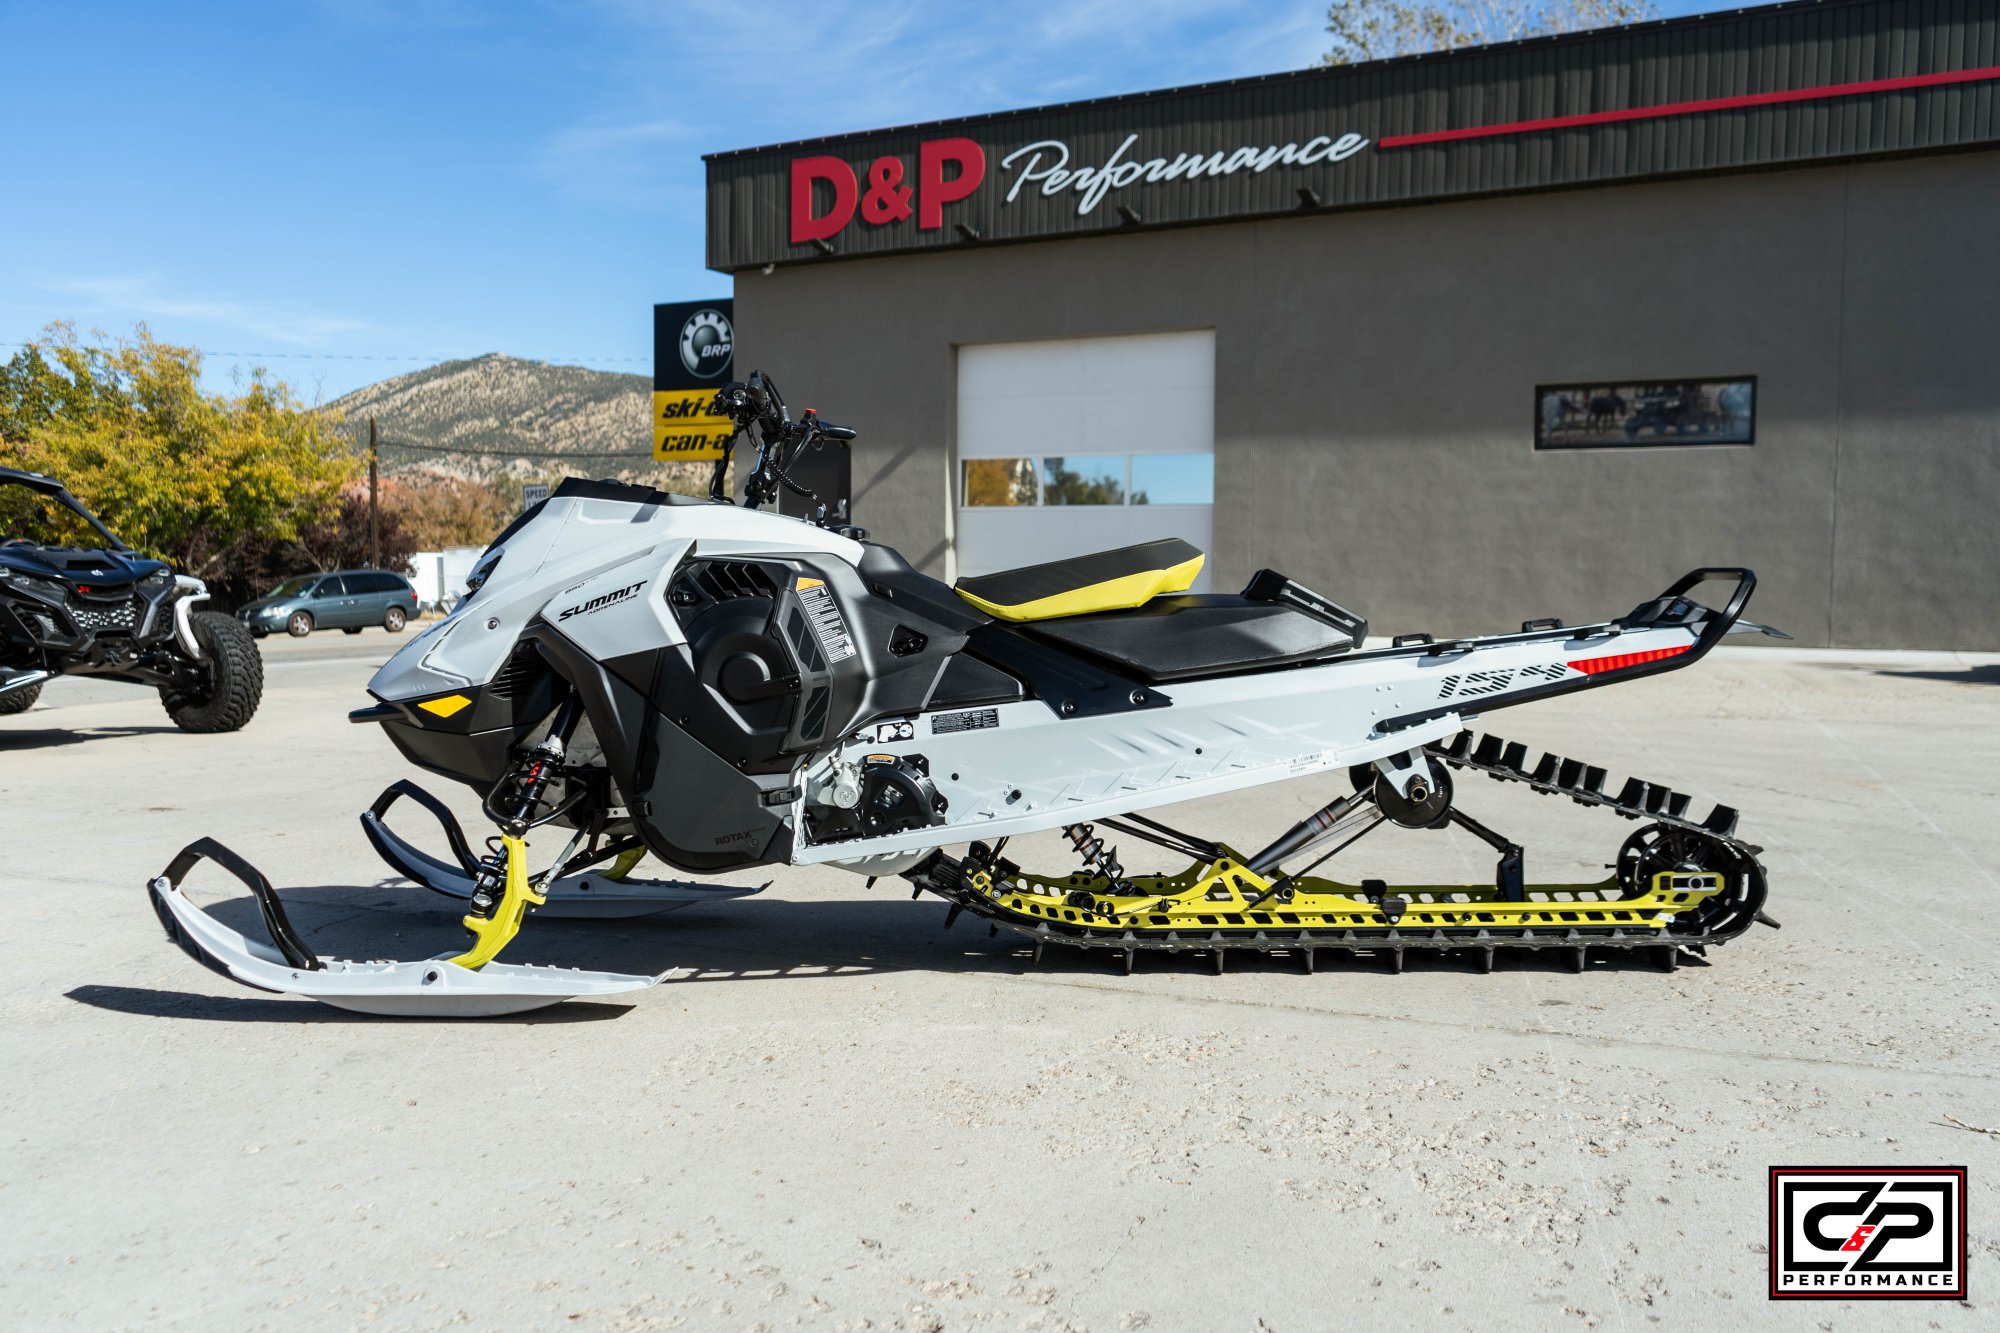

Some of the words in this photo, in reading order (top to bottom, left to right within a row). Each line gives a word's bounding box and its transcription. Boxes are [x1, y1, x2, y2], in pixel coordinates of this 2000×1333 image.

[790, 137, 986, 243] D&P
[1001, 133, 1369, 215] Performance
[701, 344, 731, 358] BRP
[525, 489, 547, 499] SPEED
[558, 580, 648, 622] SUMMIT
[587, 593, 638, 615] ADRENALINE
[715, 830, 752, 846] ROTAX
